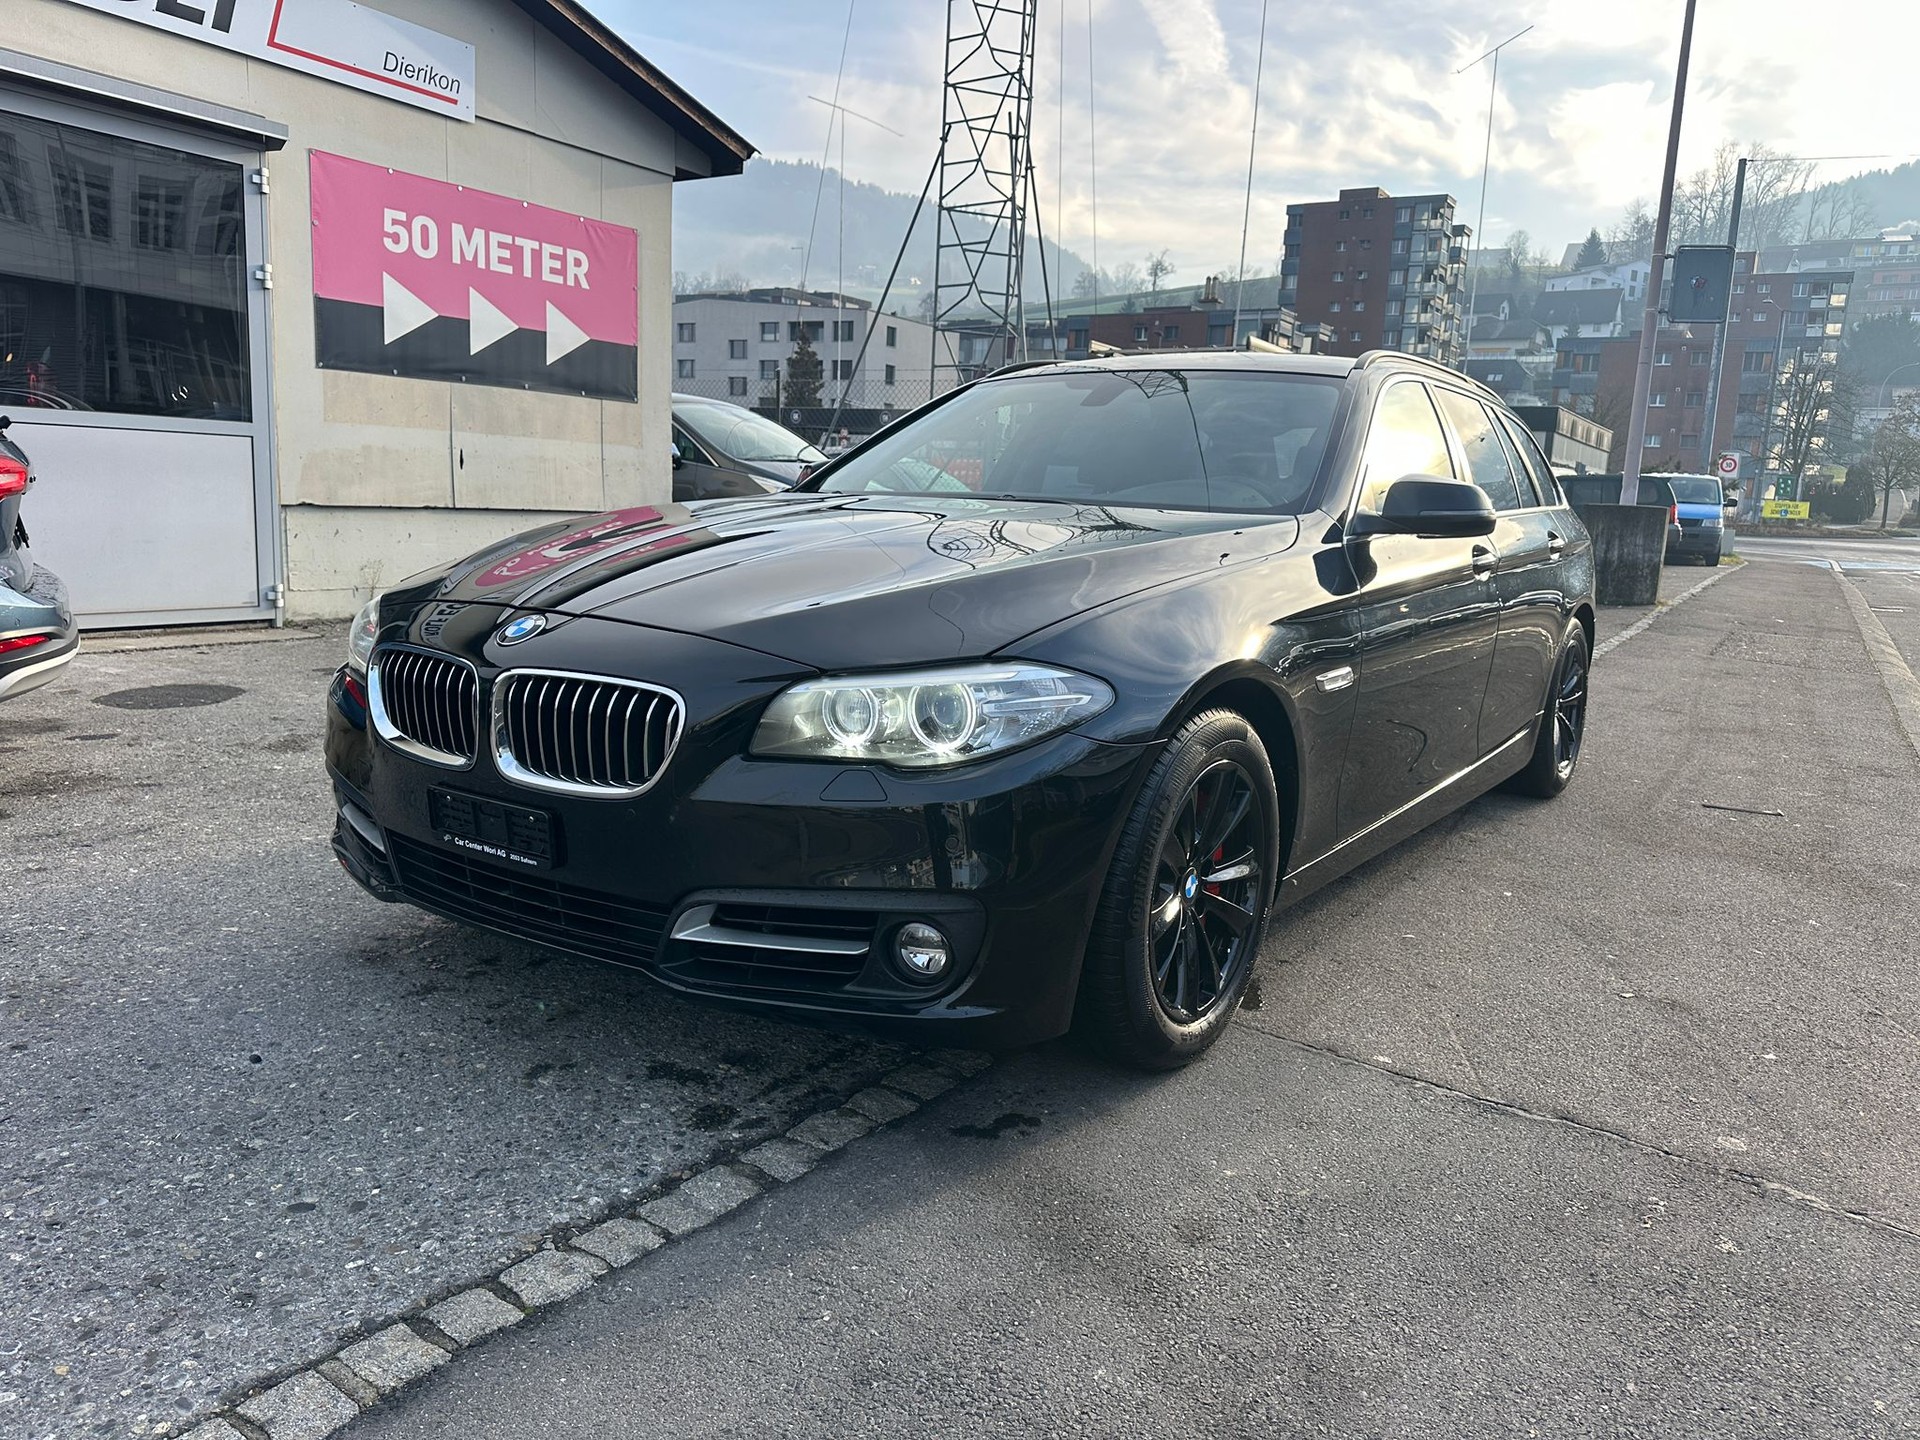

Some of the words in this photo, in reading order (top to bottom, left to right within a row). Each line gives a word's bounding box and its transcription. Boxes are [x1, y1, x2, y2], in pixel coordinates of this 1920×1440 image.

[383, 51, 461, 95] Dierikon
[383, 207, 439, 260] 50
[451, 222, 590, 290] METER
[454, 837, 464, 845] Car
[465, 841, 482, 851] Center
[497, 849, 507, 858] AG
